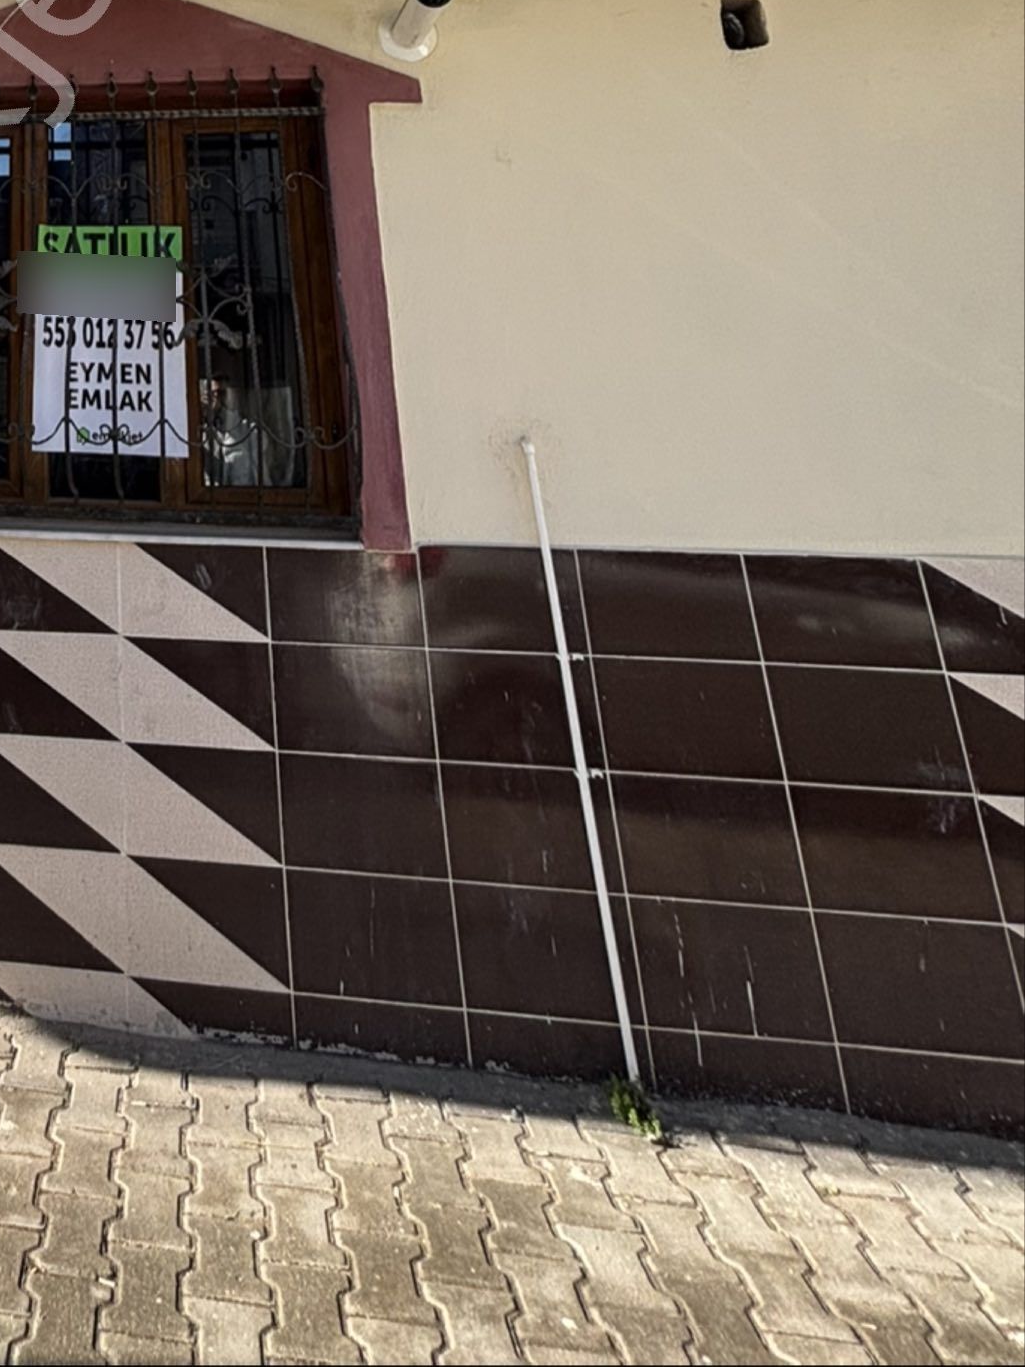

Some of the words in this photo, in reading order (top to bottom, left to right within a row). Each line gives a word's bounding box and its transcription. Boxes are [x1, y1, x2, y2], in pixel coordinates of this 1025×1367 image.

[83, 317, 116, 349] 012
[124, 320, 146, 350] 37
[151, 321, 175, 351] 56
[68, 362, 151, 385] EYMEN
[68, 389, 153, 412] EMLAK
